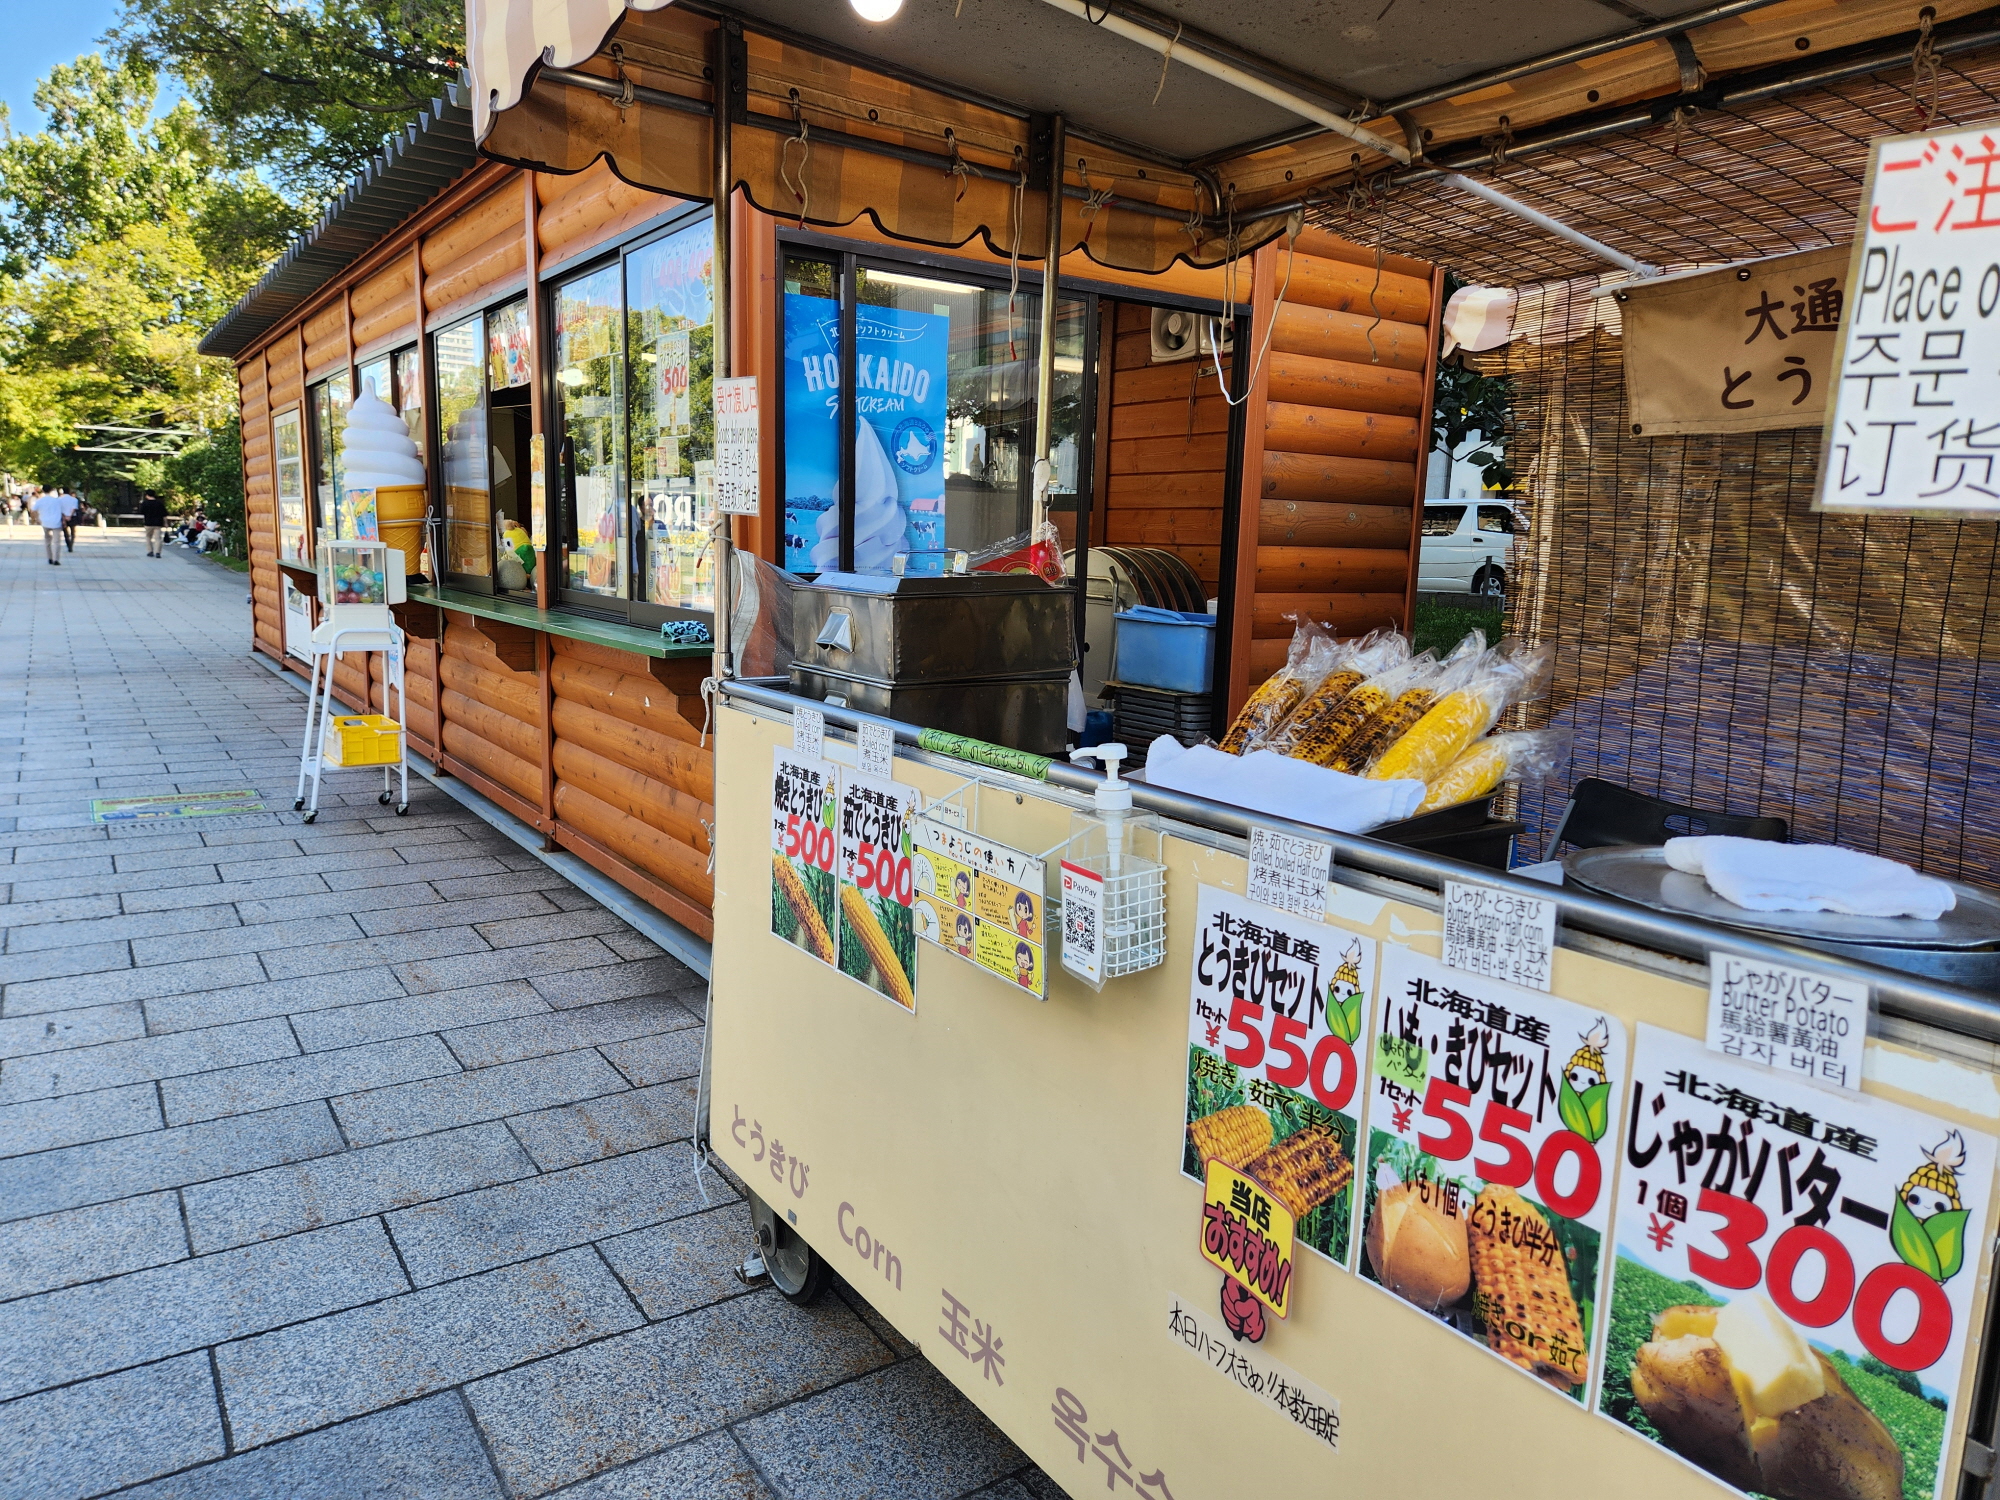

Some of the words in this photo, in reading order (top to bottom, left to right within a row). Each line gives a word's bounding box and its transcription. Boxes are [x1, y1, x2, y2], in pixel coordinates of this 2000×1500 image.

[1855, 244, 1962, 325] Place
[802, 352, 931, 403] HOKAIDO
[1844, 329, 1969, 410] 주문
[717, 383, 758, 414] 受け渡し口
[826, 394, 905, 419] STCREAM
[717, 448, 730, 476] 상품
[731, 449, 743, 477] 수령
[745, 449, 757, 477] 장소
[878, 742, 890, 754] corn
[780, 761, 821, 786] 北海道産
[774, 771, 823, 823] 焼きとうきび
[849, 783, 899, 813] 北海道産
[774, 819, 786, 832] 1本
[842, 795, 903, 853] 茹でとうきび
[842, 846, 858, 861] 1本
[933, 830, 1015, 874] つまようじの使い方
[948, 849, 958, 858] How
[1275, 852, 1295, 872] boiled
[1297, 859, 1311, 877] Half
[1312, 866, 1326, 881] corn
[1073, 881, 1097, 898] PayPay
[1249, 883, 1269, 904] 구이와
[1271, 891, 1285, 909] 보일
[1287, 894, 1300, 914] 절반
[1303, 899, 1323, 921] 옥수수
[1254, 865, 1325, 900] 烤煮半玉米
[1212, 911, 1320, 966] 北海道産
[1448, 902, 1471, 925] Butter
[1524, 924, 1543, 942] corn
[1197, 927, 1325, 1030] とうきびセット
[1448, 945, 1468, 970] 감자
[1512, 961, 1544, 990] 옥수수
[1725, 961, 1853, 1005] じゃがバター
[1196, 998, 1227, 1025] 1セット
[1406, 978, 1550, 1048] 北海道産
[1722, 981, 1778, 1018] Butter
[1785, 995, 1849, 1037] Potato
[1720, 1033, 1778, 1066] 감자
[1791, 1052, 1847, 1087] 버터
[1380, 1077, 1422, 1107] 1セット
[1663, 1069, 1878, 1162] 北海道産
[731, 1104, 810, 1198] とうきび
[1627, 1080, 1889, 1231] じゃがバター
[1230, 1178, 1271, 1232] 当店
[1637, 1180, 1688, 1223] 1個
[837, 1201, 902, 1291] Corn
[1204, 1200, 1291, 1308] おすすめ!
[938, 1288, 1006, 1387] 玉米
[1471, 1288, 1506, 1329] 焼き
[1505, 1319, 1546, 1348] or
[1549, 1334, 1586, 1374] 茹で
